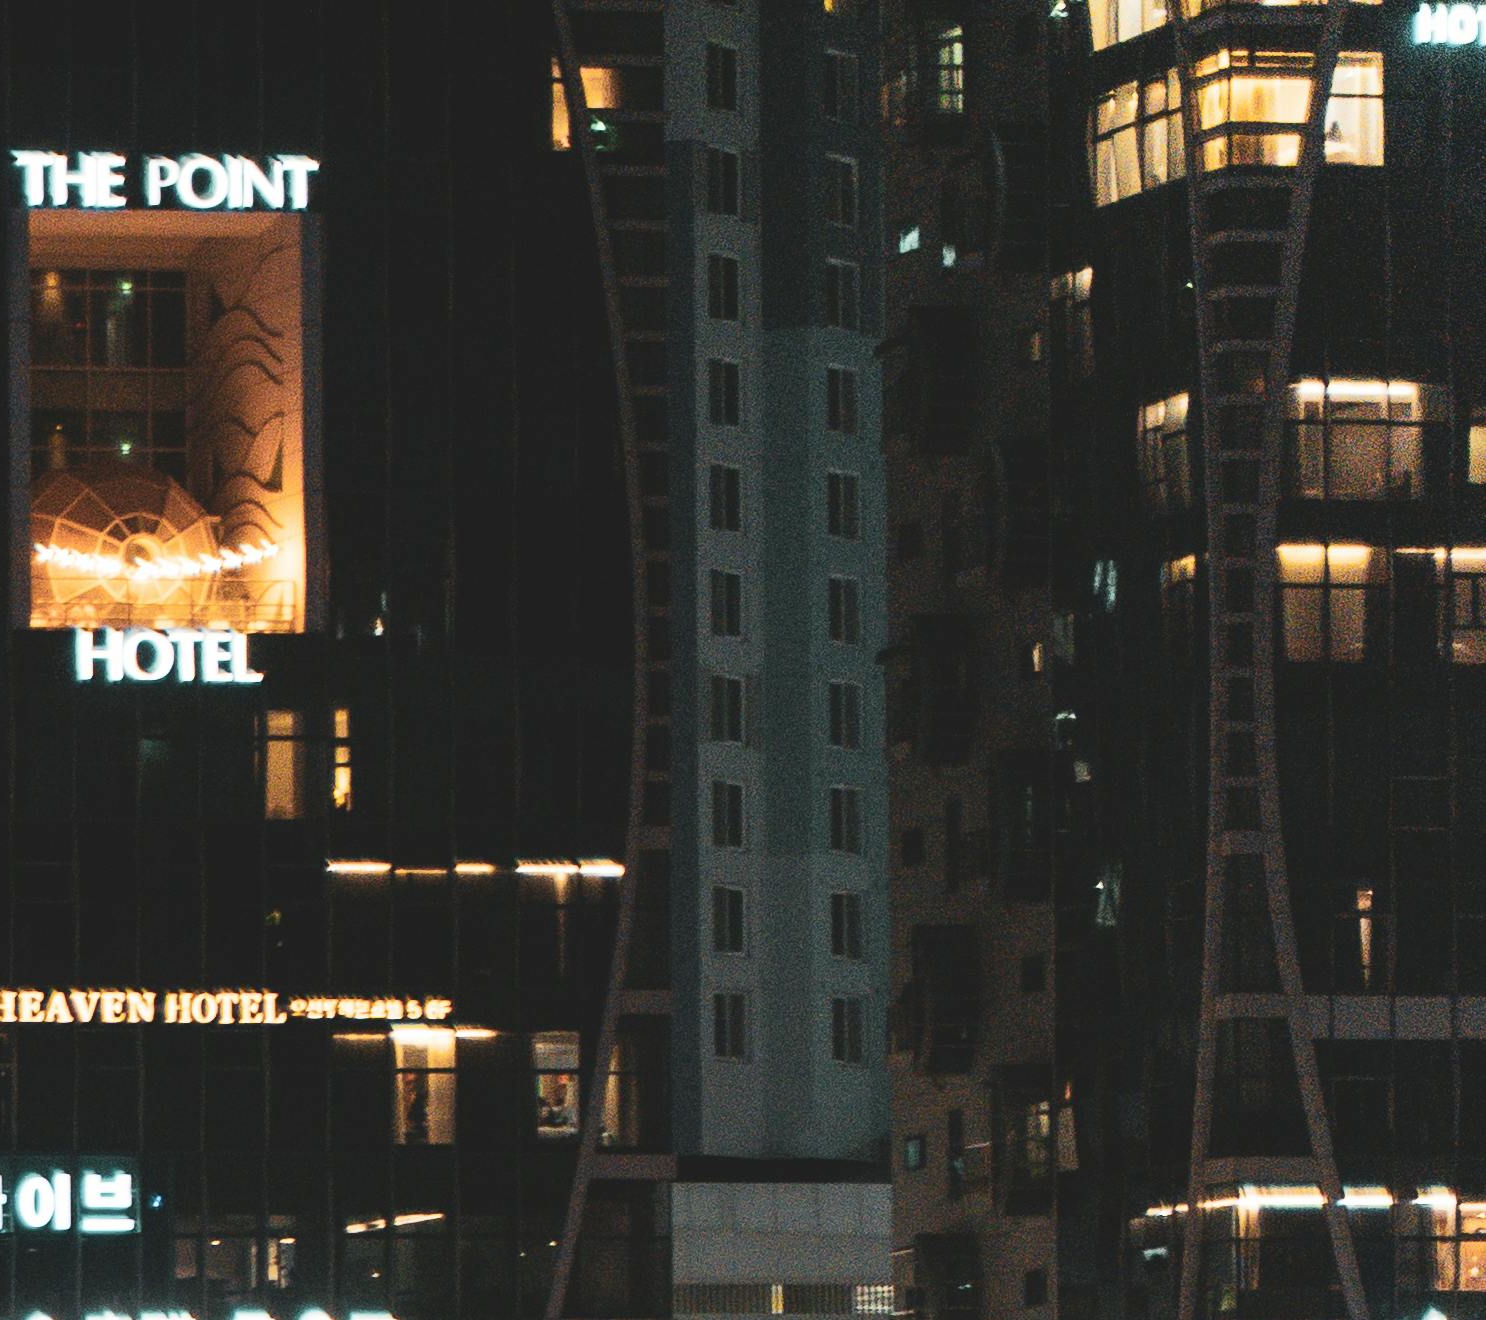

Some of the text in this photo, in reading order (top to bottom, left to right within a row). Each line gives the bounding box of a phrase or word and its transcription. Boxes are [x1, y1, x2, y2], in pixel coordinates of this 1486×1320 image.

[11, 150, 320, 211] THE POINT
[75, 628, 265, 682] HOTEL
[165, 990, 287, 1024] HOTEL
